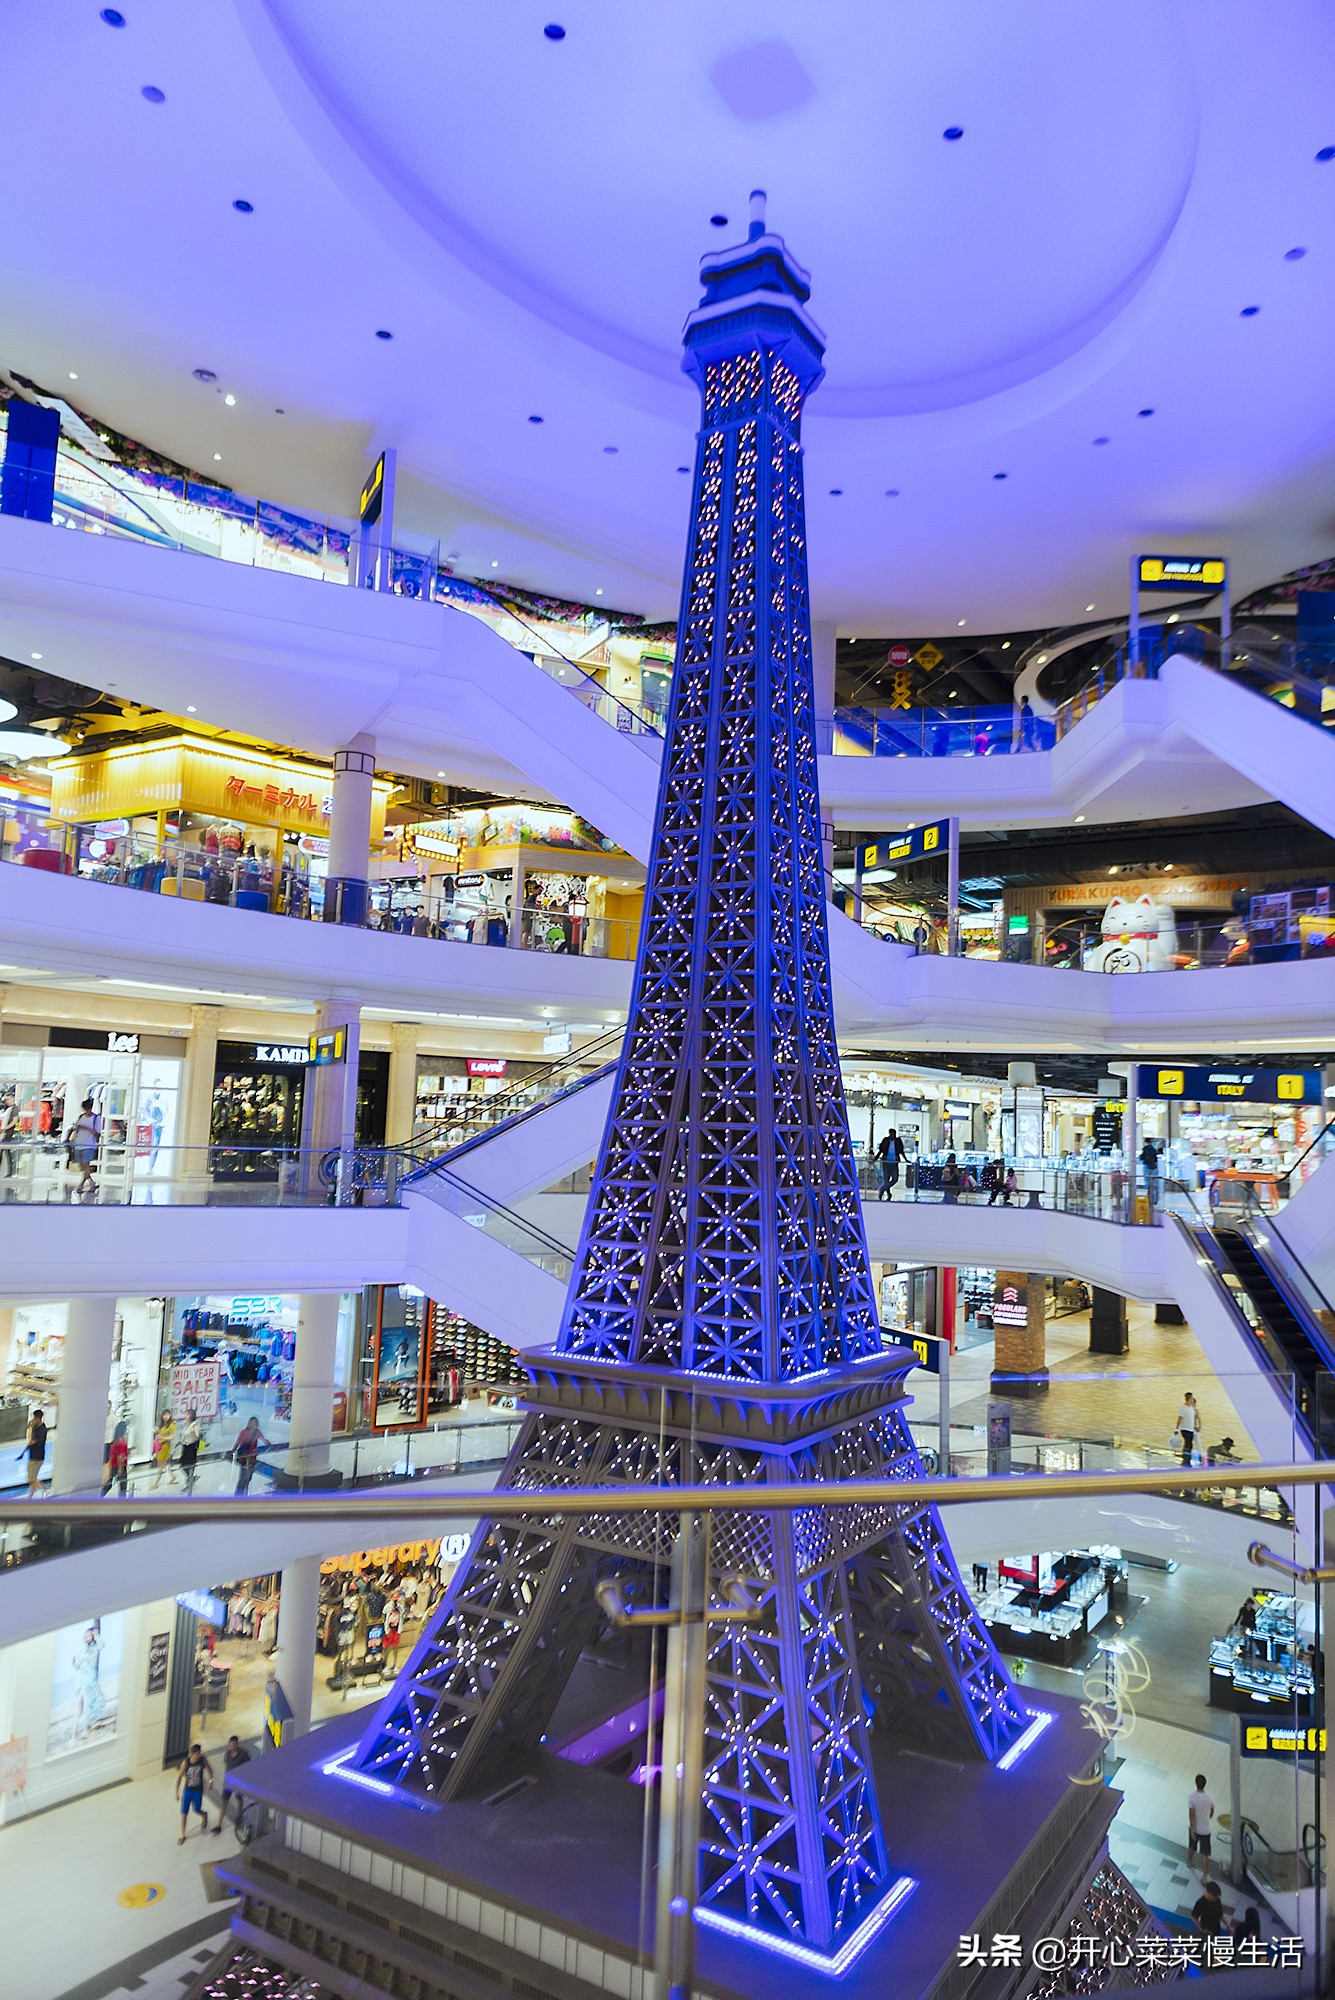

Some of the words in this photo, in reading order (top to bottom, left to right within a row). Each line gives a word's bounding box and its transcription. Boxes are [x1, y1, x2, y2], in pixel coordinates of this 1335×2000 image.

[226, 775, 318, 811] ターミナル
[928, 832, 934, 845] 2
[890, 846, 910, 858] TOKYO
[1050, 884, 1144, 901] YURAKUCHO
[1151, 878, 1248, 895] CONCOURSE
[107, 1031, 139, 1053] Lee
[1217, 1085, 1245, 1096] ITALY
[231, 1296, 282, 1317] SBR
[993, 1302, 1028, 1313] FOODLAND
[173, 1369, 189, 1380] MID
[194, 1367, 214, 1379] YEAR
[172, 1379, 214, 1396] SALE
[170, 1398, 180, 1407] UP
[180, 1395, 212, 1415] 50%
